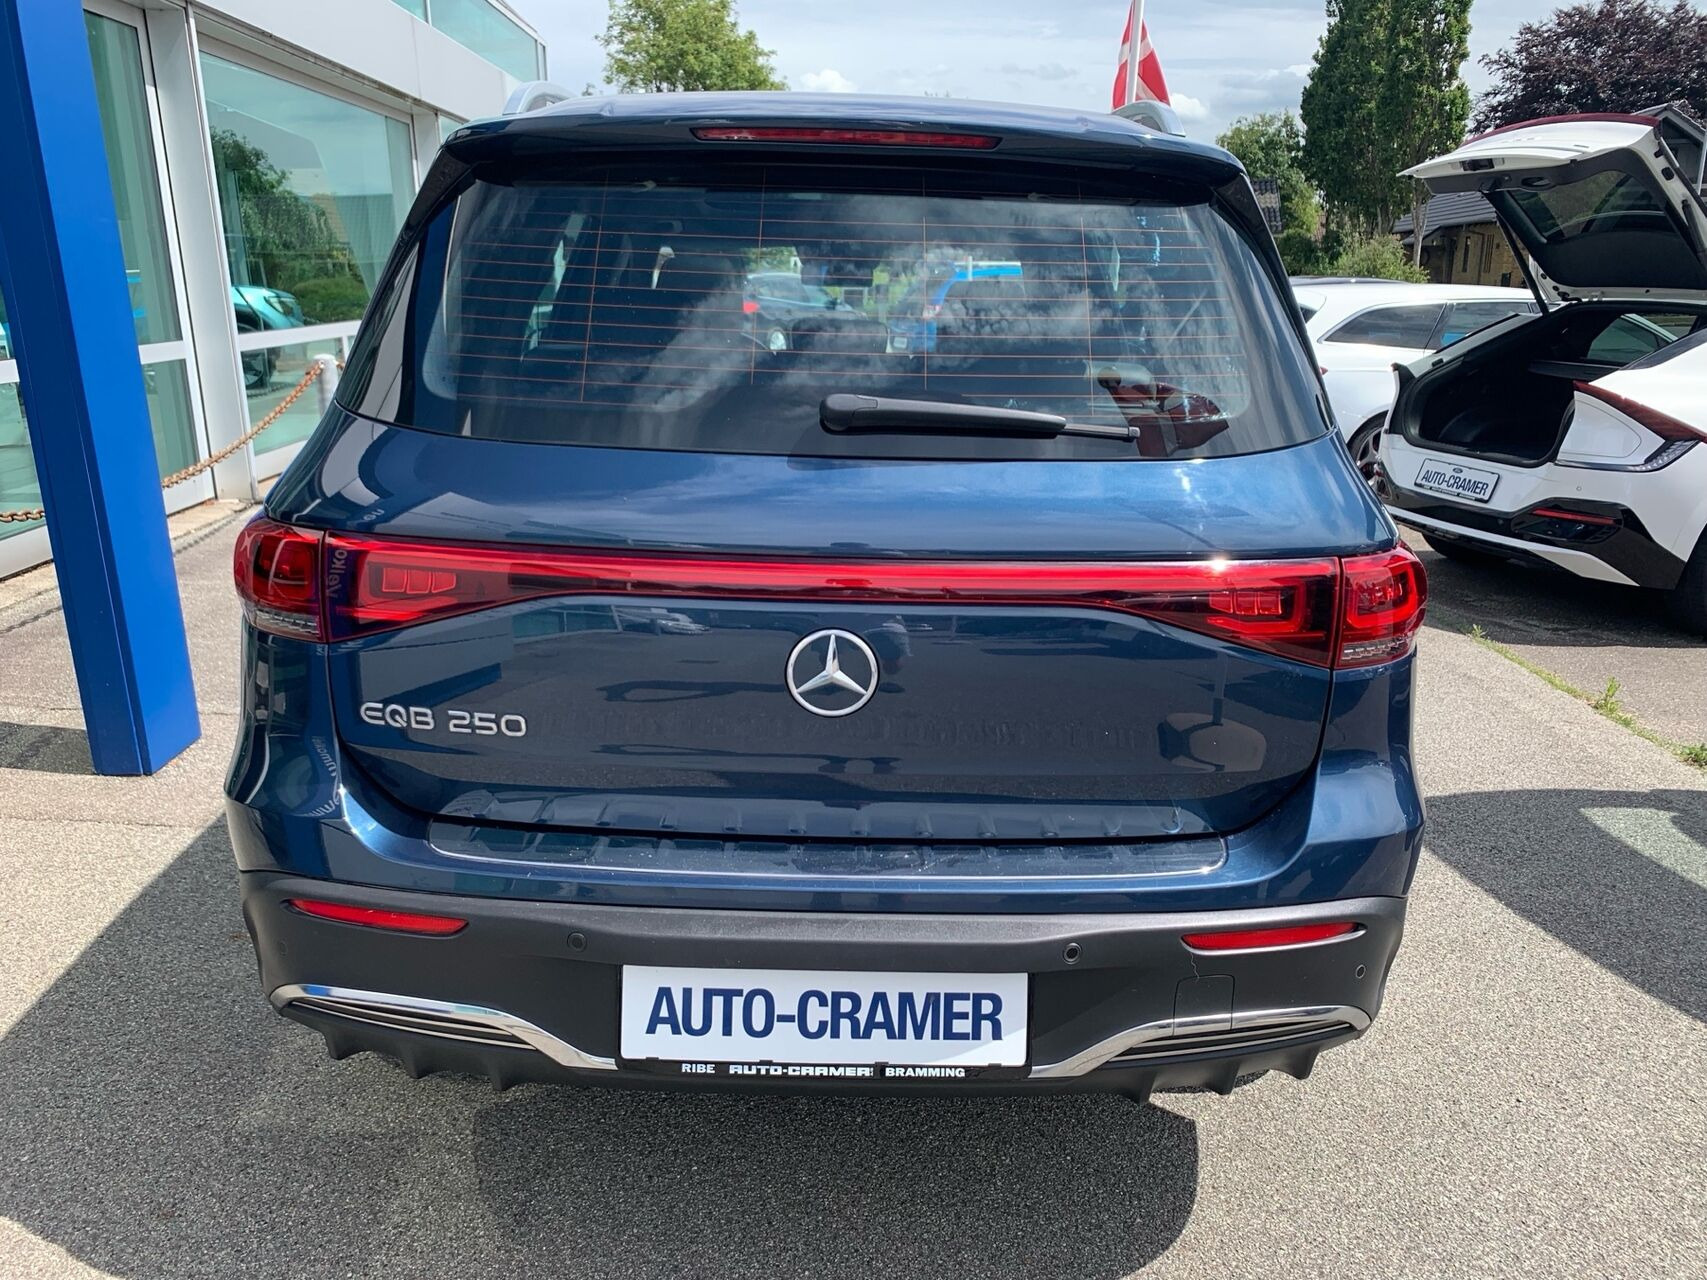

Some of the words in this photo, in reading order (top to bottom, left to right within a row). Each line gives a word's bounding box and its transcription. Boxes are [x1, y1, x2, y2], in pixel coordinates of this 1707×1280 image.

[1421, 469, 1489, 496] AUTO-CRAMER
[360, 702, 434, 728] EQB
[448, 710, 527, 737] 250
[645, 986, 1003, 1041] AUTO-CRAMER
[681, 1063, 716, 1074] RIBE
[885, 1067, 966, 1078] BRAMMING
